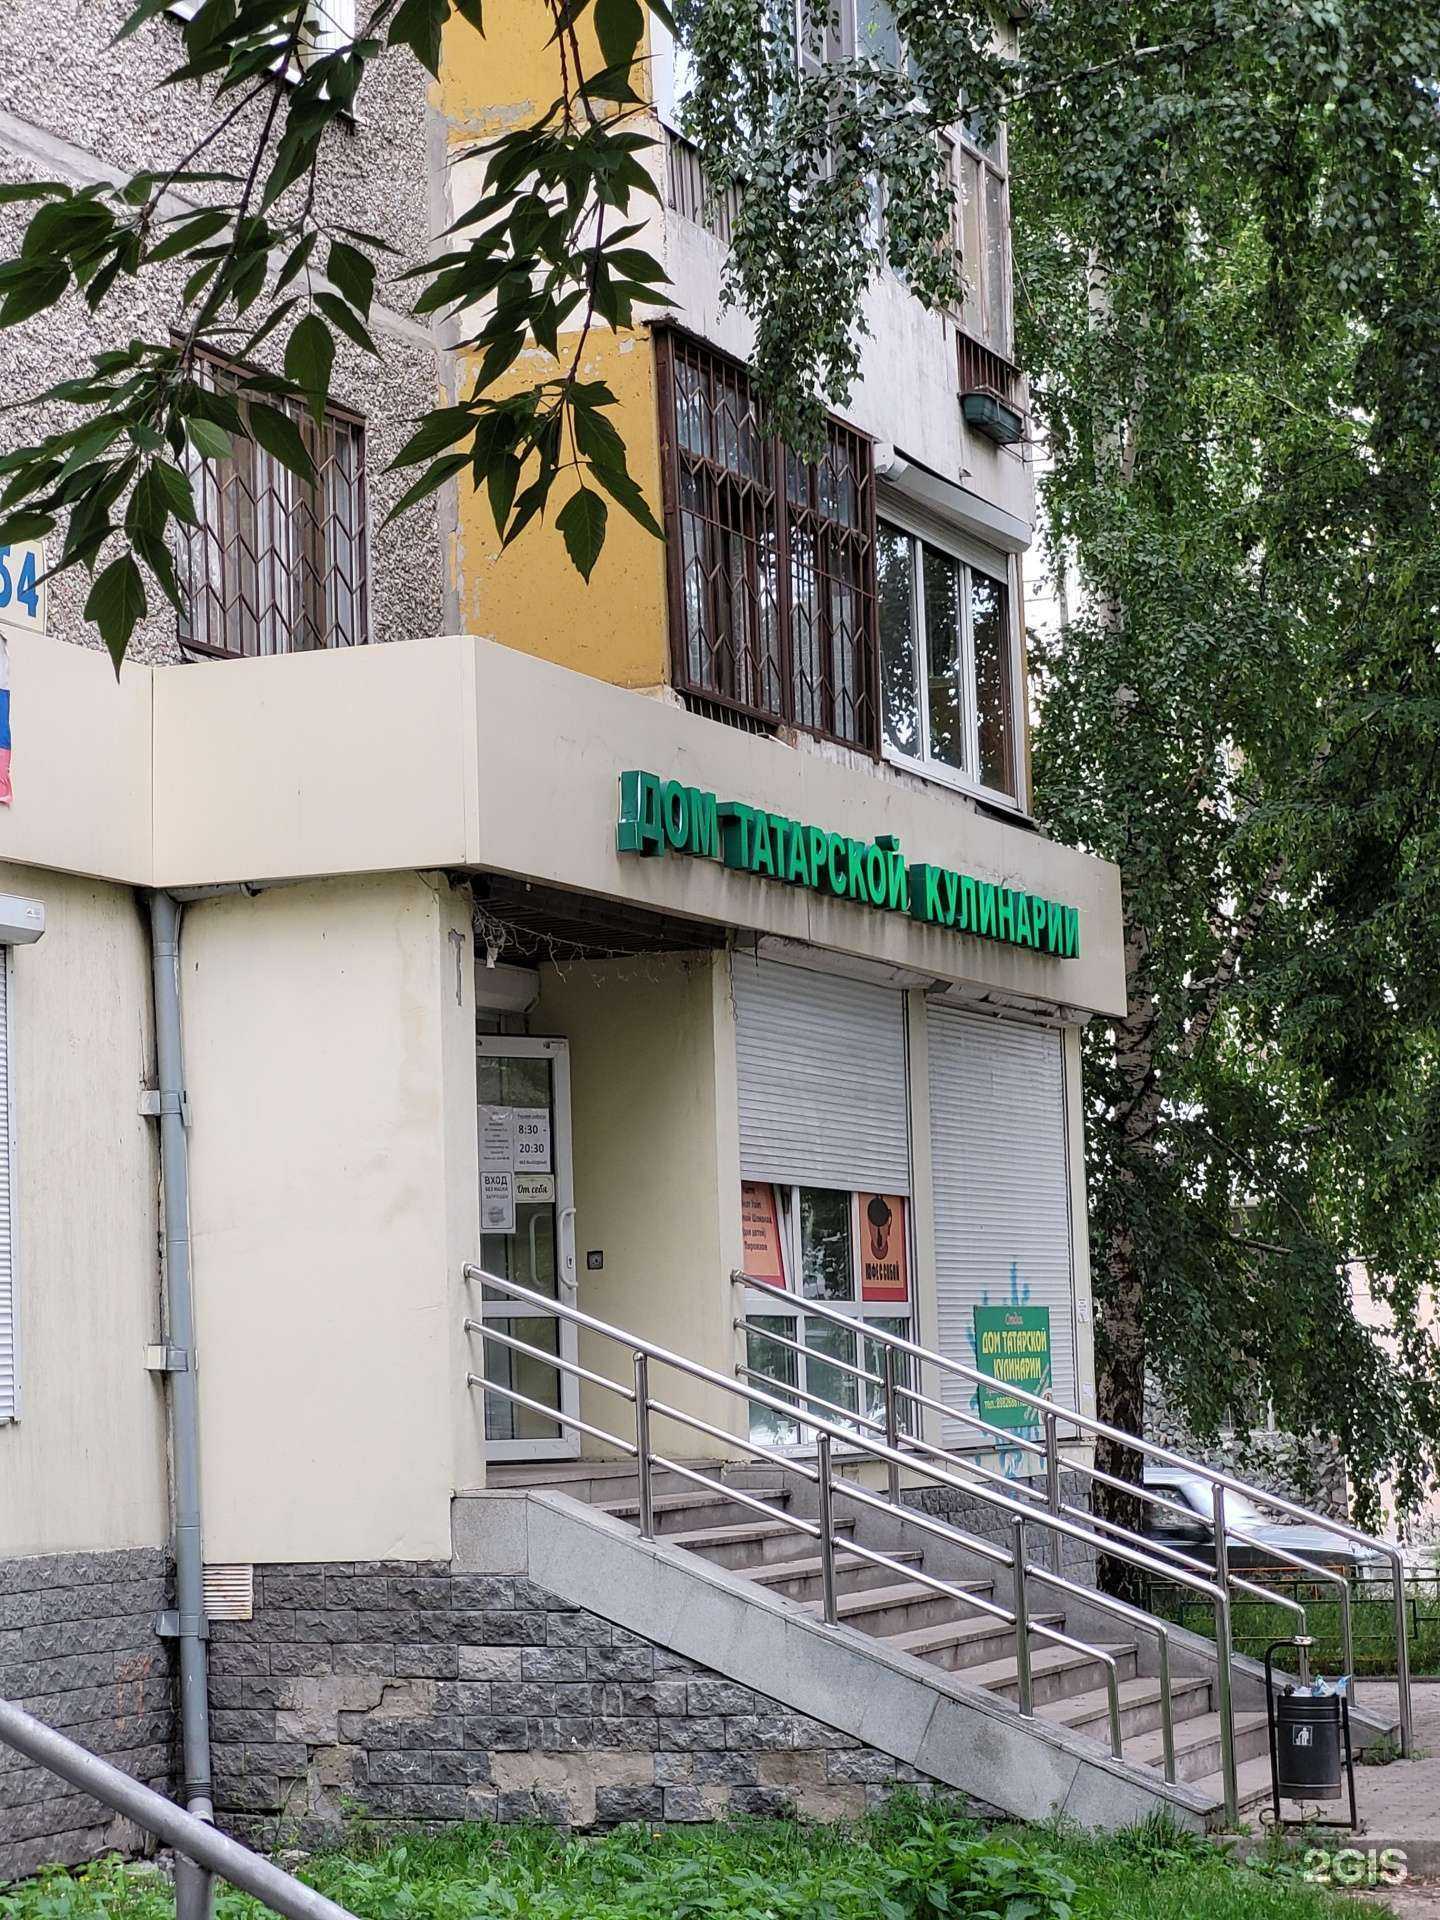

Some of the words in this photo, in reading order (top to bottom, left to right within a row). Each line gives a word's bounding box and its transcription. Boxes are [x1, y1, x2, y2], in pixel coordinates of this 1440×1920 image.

[617, 769, 718, 858] ДОМ
[716, 801, 908, 912] ТАТАРСКОЙ
[910, 862, 1080, 959] КУЛИНАРИИ
[518, 1124, 539, 1135] 8:30
[519, 1143, 545, 1154] 20:30
[484, 1175, 508, 1186] ВХОД
[517, 1183, 530, 1195] От
[531, 1183, 548, 1194] себя
[982, 1331, 1001, 1354] ДОМ
[1002, 1327, 1047, 1355] ТАТАРСКОЙ
[993, 1357, 1041, 1381] КУЛИНАРИИ
